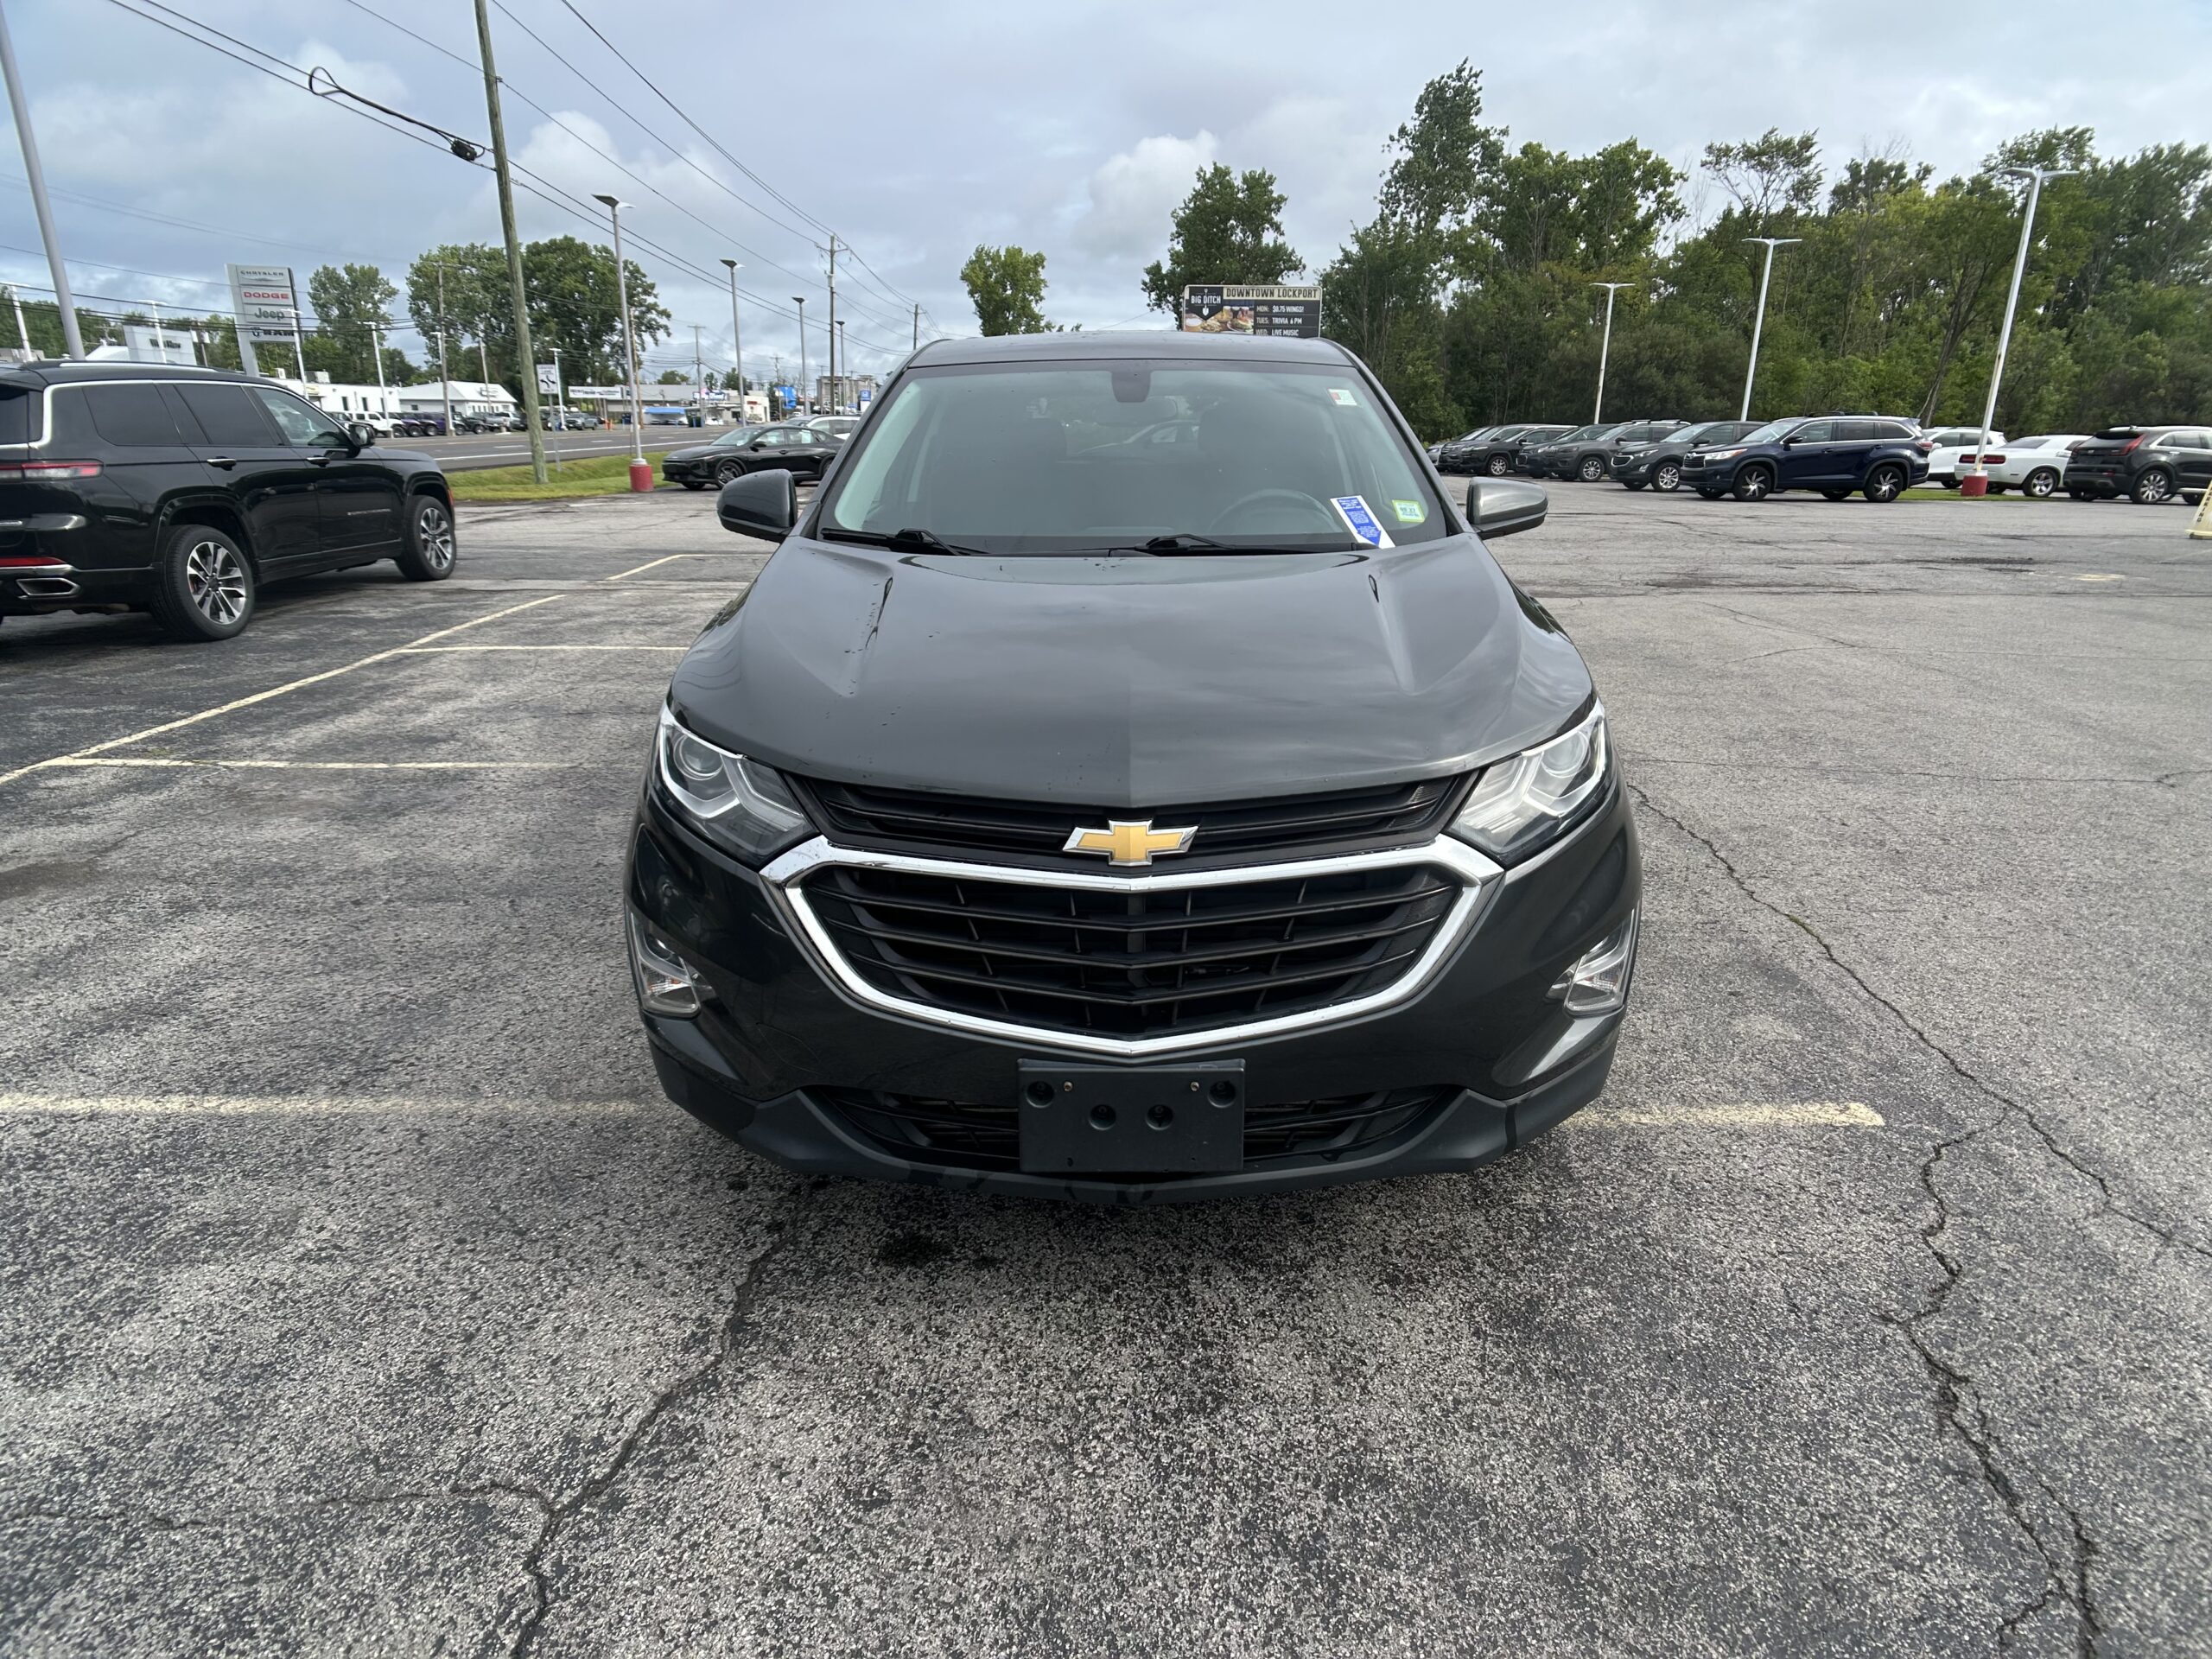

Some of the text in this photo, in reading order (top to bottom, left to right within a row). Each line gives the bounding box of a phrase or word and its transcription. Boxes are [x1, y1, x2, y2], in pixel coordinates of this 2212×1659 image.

[1191, 295, 1221, 303] BIG DITCH
[1226, 288, 1318, 298] DOWNTOWN LOCKPORT
[254, 307, 285, 321] Jeep
[2196, 486, 2212, 523] ARKING
